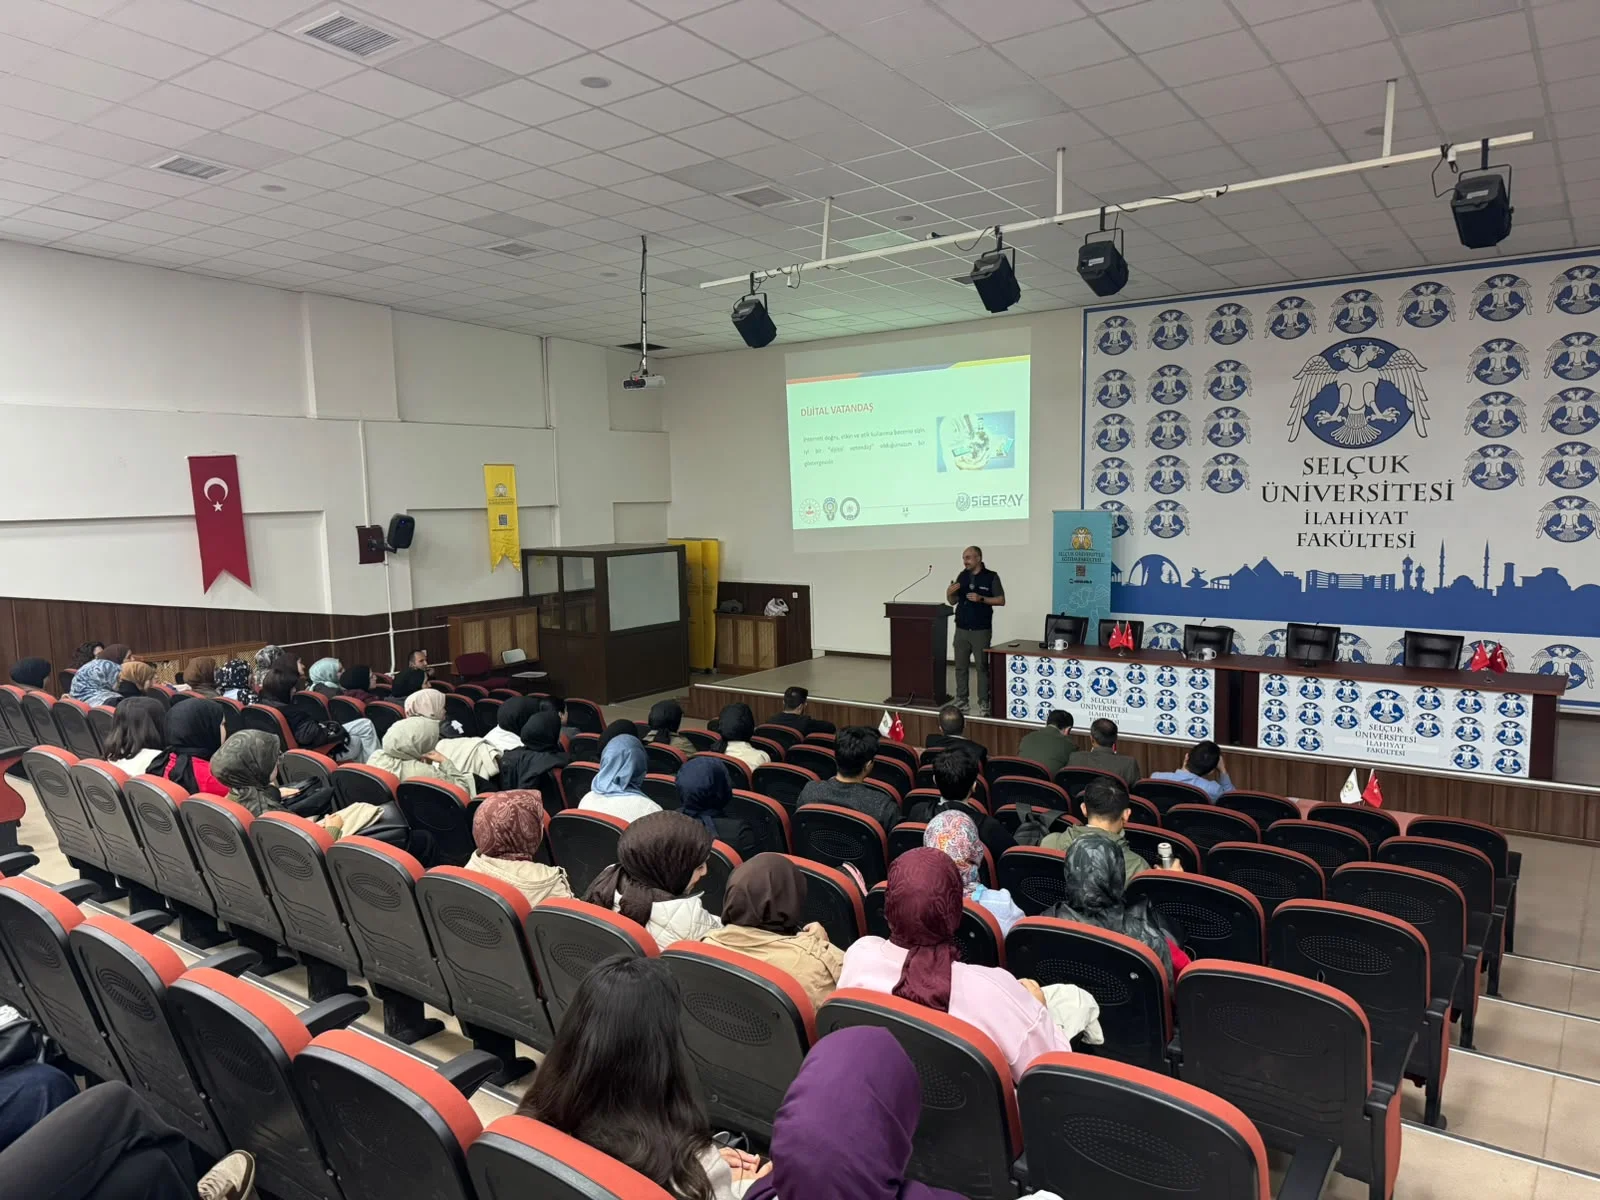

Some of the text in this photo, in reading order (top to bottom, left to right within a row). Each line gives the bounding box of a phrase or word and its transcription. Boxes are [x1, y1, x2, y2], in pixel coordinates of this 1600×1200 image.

[830, 402, 874, 414] VATANDAŞ
[1302, 454, 1410, 480] SELÇUK
[1261, 479, 1456, 504] ÜNİVERSİTESİ
[1304, 509, 1409, 526] İLAHİYAT
[1296, 529, 1417, 550] FAKÜLTESİ
[1090, 697, 1118, 706] SELÇUK
[1080, 702, 1128, 714] ÜNİVERSİTESİ
[1368, 723, 1404, 734] SELÇUK
[1355, 729, 1417, 744] ÜNİVERSİTESİ
[1366, 739, 1406, 749] İLAHİYAT
[1366, 747, 1406, 757] FAKÜLTESİ
